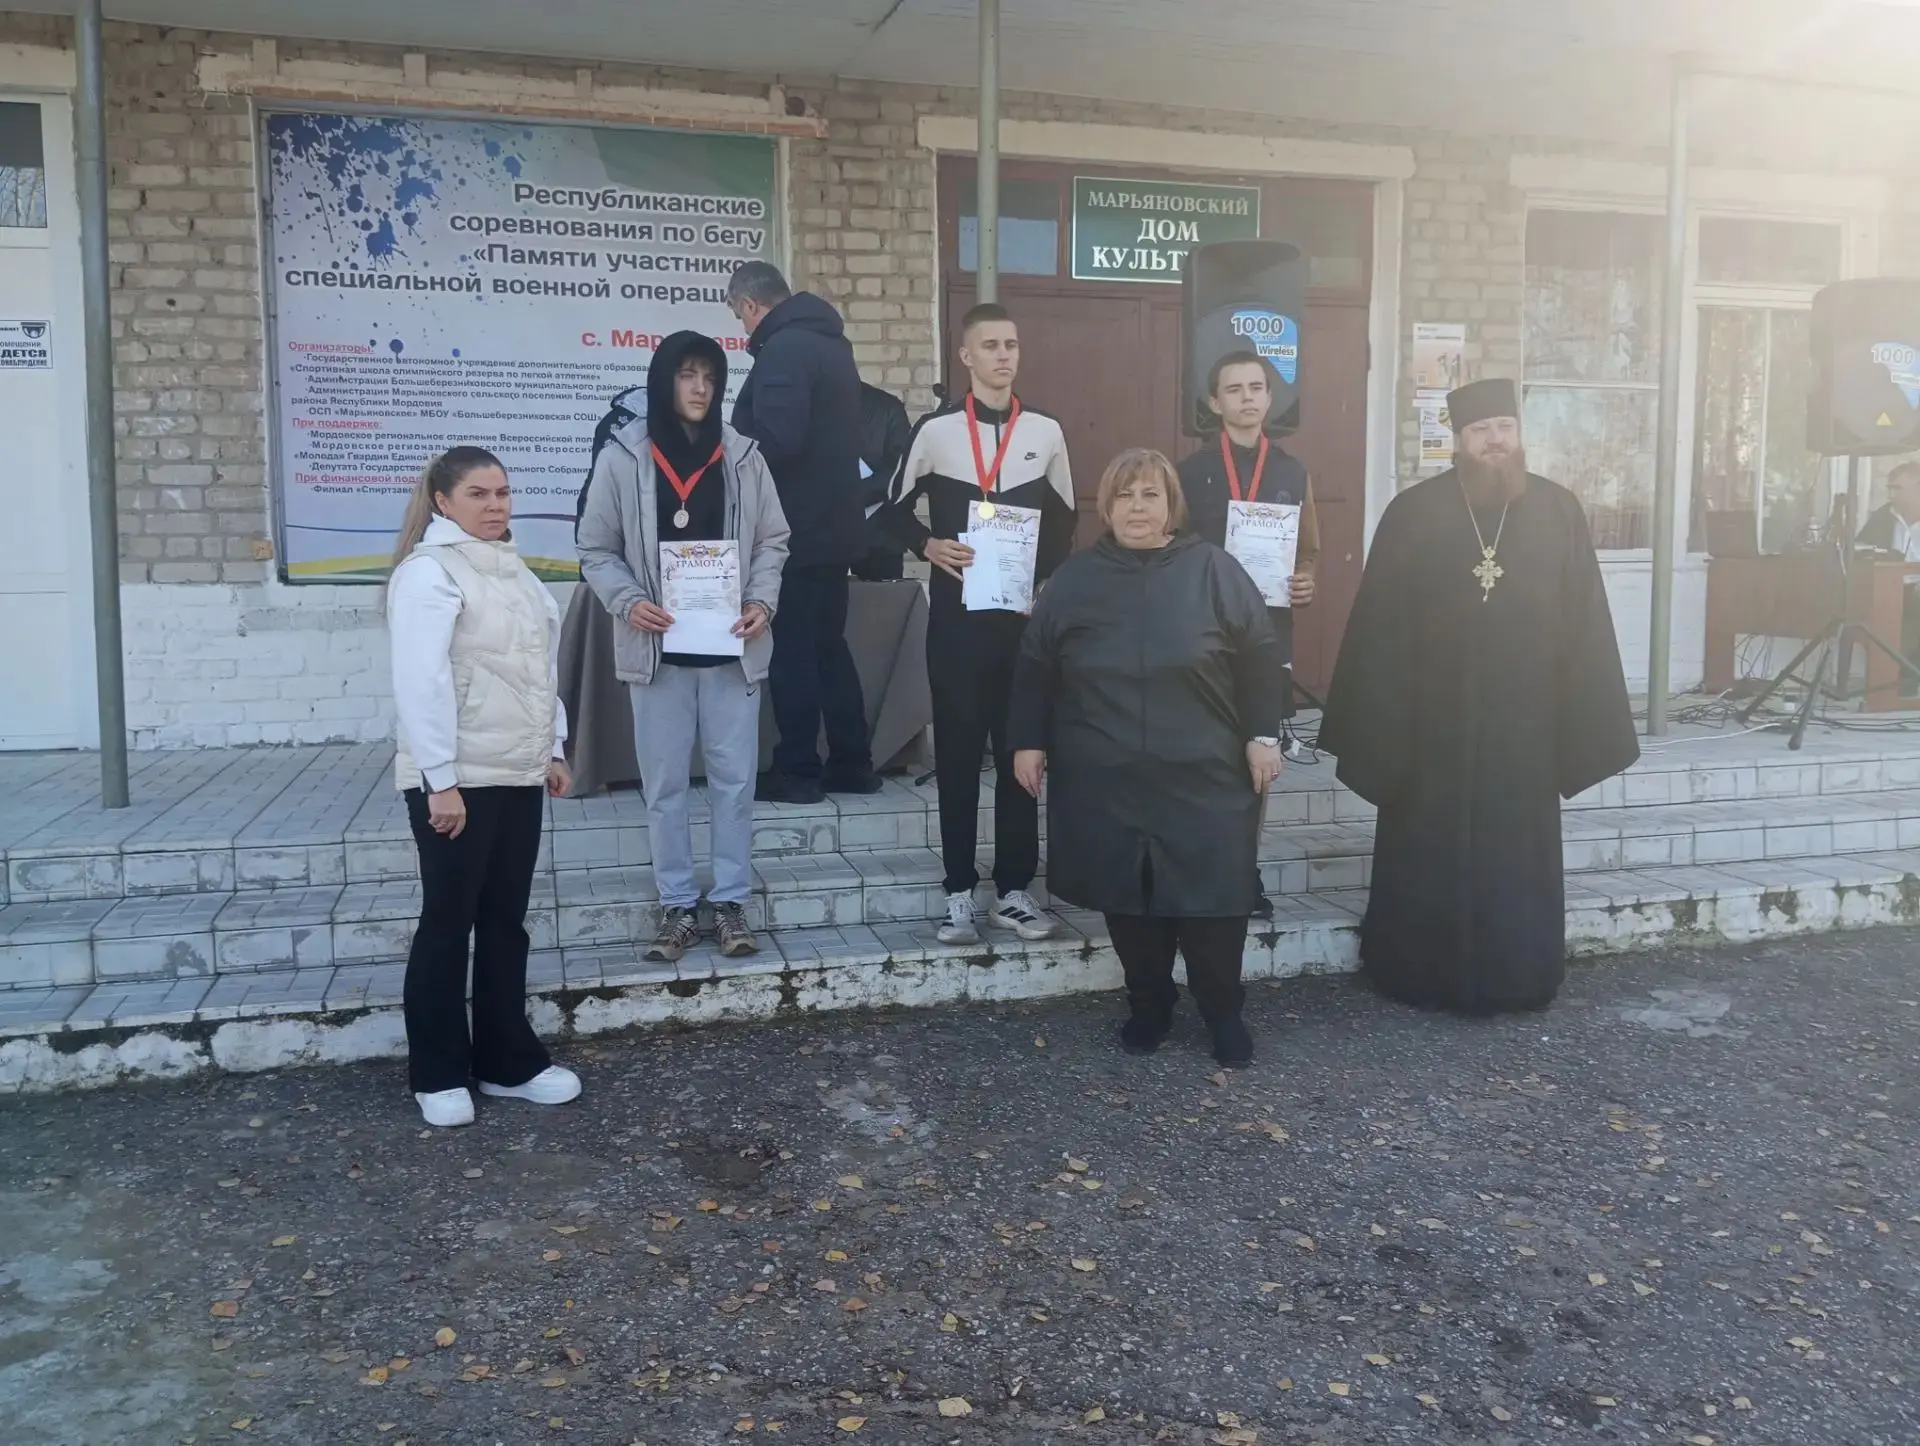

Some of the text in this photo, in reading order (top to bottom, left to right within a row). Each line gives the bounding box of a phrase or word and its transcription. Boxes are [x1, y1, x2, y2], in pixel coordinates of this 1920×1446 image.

[514, 183, 762, 217] Республиканские
[1088, 191, 1249, 216] МАРЬЯНОВСКИЙ
[450, 215, 763, 250] соревнования по бегу
[1137, 218, 1200, 243] ДОМ
[473, 244, 746, 273] «Памяти участнико
[1092, 246, 1188, 271] КУЛЬТ
[285, 270, 482, 293] специальной
[493, 278, 610, 298] военной
[1231, 316, 1284, 335] 1000
[581, 332, 602, 347] с.
[0, 350, 47, 358] ДЕТСЯ
[288, 341, 375, 354] Организаторы:
[1258, 345, 1295, 356] Wireless
[1871, 346, 1914, 365] 1000
[457, 360, 516, 369] учреждение
[517, 361, 601, 371] дополнительного
[359, 366, 390, 375] школа
[465, 371, 505, 379] резерва
[307, 375, 390, 387] Администрация
[514, 382, 594, 391] муниципального
[308, 386, 390, 397] Администрация
[391, 387, 468, 399] Марьяновского
[470, 391, 520, 400] сельского
[521, 393, 573, 401] поселения
[330, 397, 390, 408] Республики
[392, 400, 443, 408] Мордовия
[308, 406, 332, 416] ОСП
[420, 409, 449, 418] МБОУ
[292, 417, 383, 429] При поддержке:
[310, 430, 372, 440] Мордовское
[374, 432, 444, 441] региональное
[446, 434, 498, 442] отделение
[500, 434, 573, 443] Всероссийской
[312, 441, 385, 450] Мордовское
[294, 451, 345, 461] «Молодая
[347, 453, 389, 462] Гвардия
[391, 453, 429, 462] Единой
[311, 462, 358, 472] Депутата
[295, 473, 318, 483] При
[320, 474, 392, 484] финансовой
[313, 486, 354, 494] Филиал
[525, 487, 548, 495] ООО
[676, 560, 724, 568] ГРАМОТА
